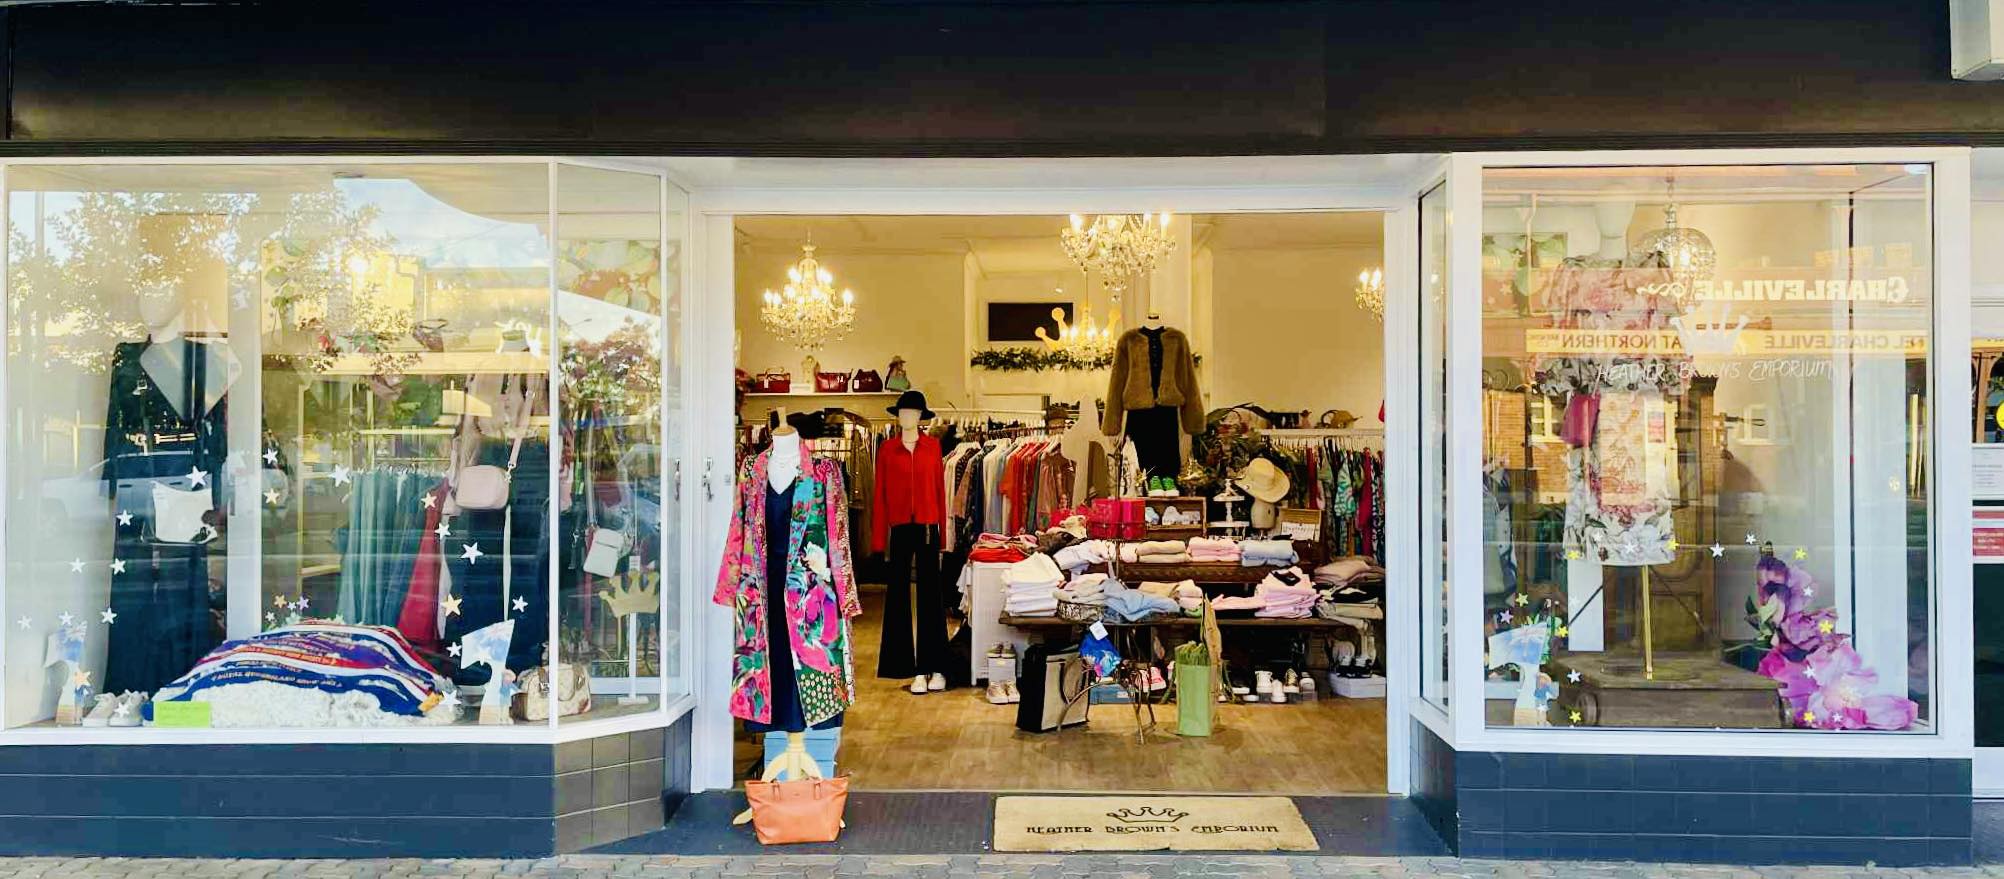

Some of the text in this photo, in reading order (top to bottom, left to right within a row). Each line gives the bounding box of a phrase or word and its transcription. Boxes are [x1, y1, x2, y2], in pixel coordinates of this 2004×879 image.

[1748, 358, 1834, 381] EMPORIUM
[1026, 826, 1093, 835] HEATHER
[1191, 825, 1280, 834] EMPORIUM
